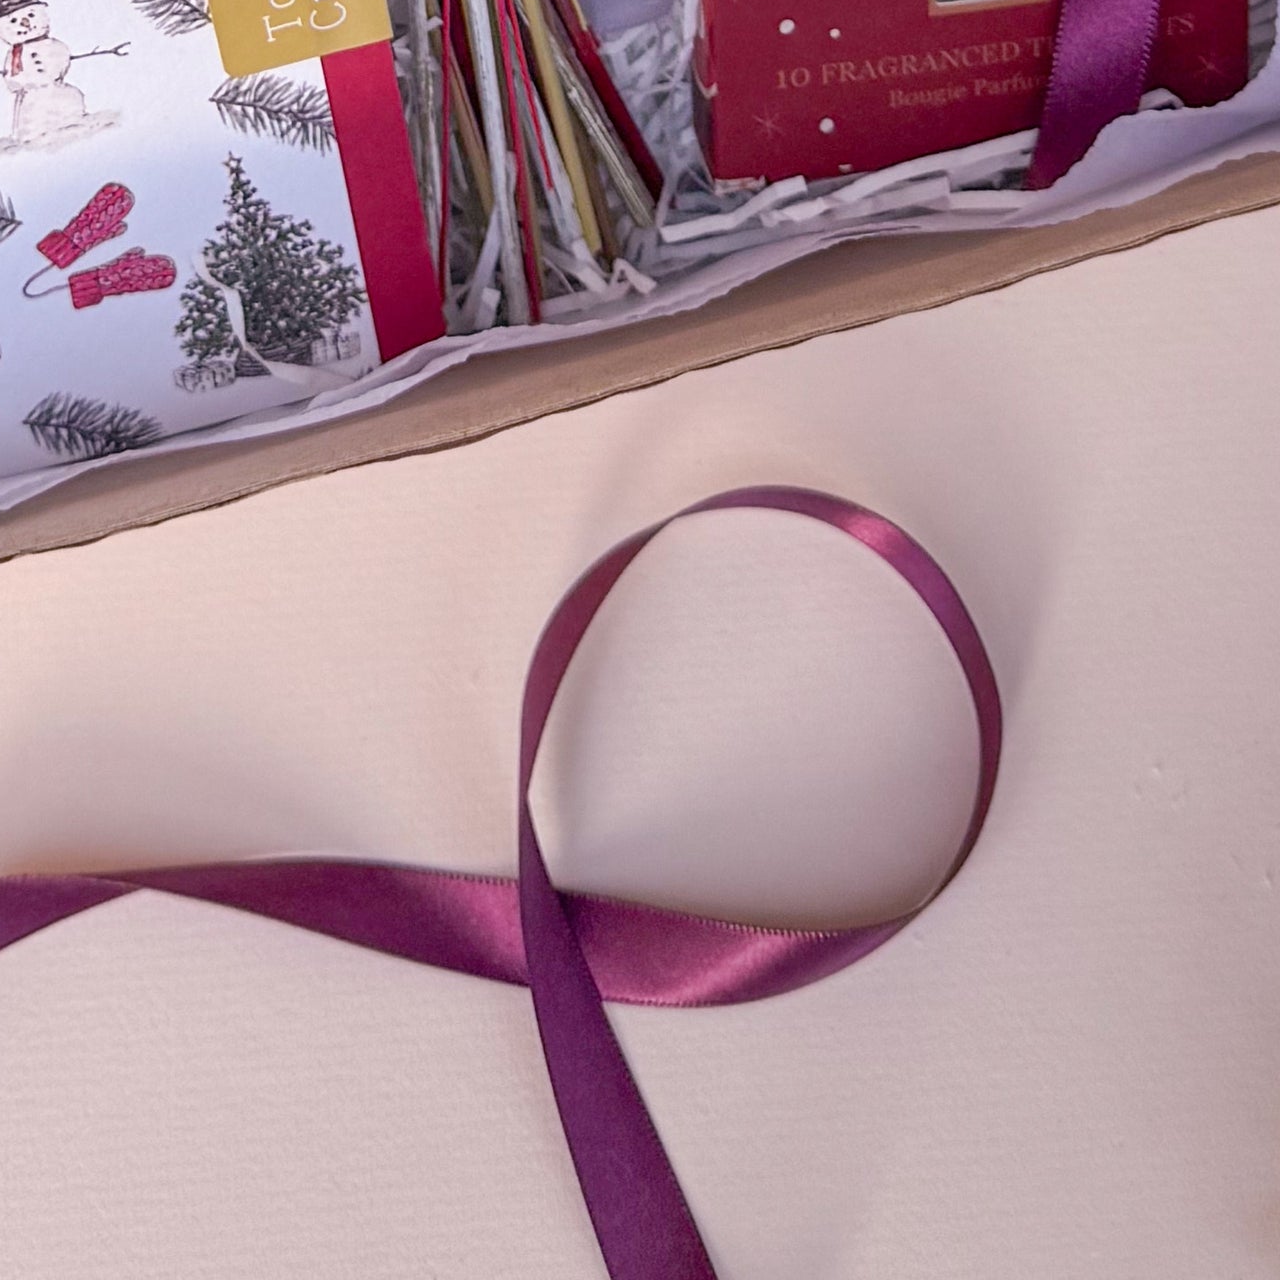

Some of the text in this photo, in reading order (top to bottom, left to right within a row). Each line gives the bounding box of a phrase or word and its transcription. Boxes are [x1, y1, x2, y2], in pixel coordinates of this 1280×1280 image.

[775, 41, 1021, 90] 10 FRAGRANCED
[887, 85, 968, 109] Bougie
